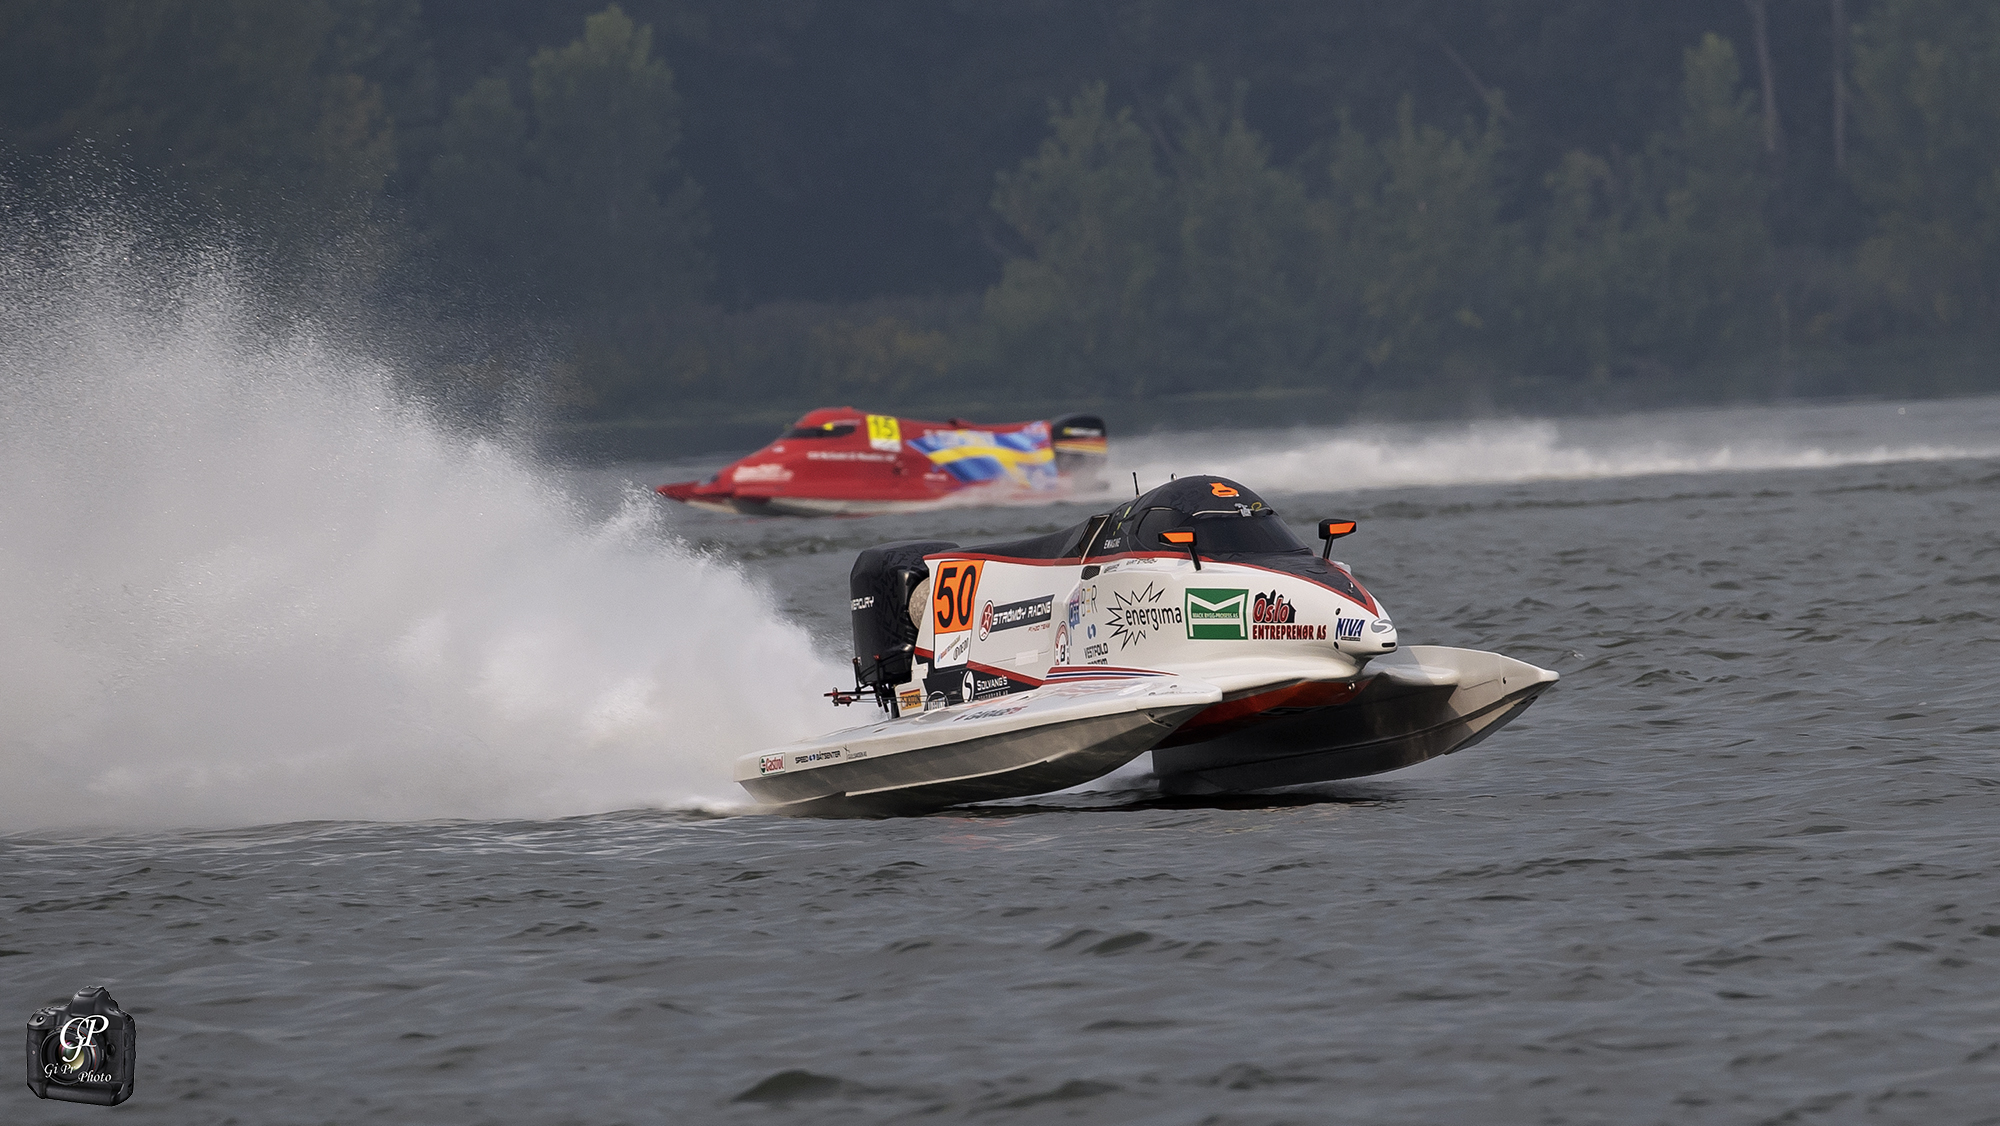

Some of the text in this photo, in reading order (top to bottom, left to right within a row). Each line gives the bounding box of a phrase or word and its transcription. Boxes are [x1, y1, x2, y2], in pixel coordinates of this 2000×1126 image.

[937, 565, 976, 628] 50
[1028, 601, 1051, 618] RACING
[1126, 606, 1182, 631] energima
[1253, 598, 1290, 623] Oslo
[1253, 625, 1327, 640] ENTREPRENØR AS
[1334, 617, 1366, 640] NIVA
